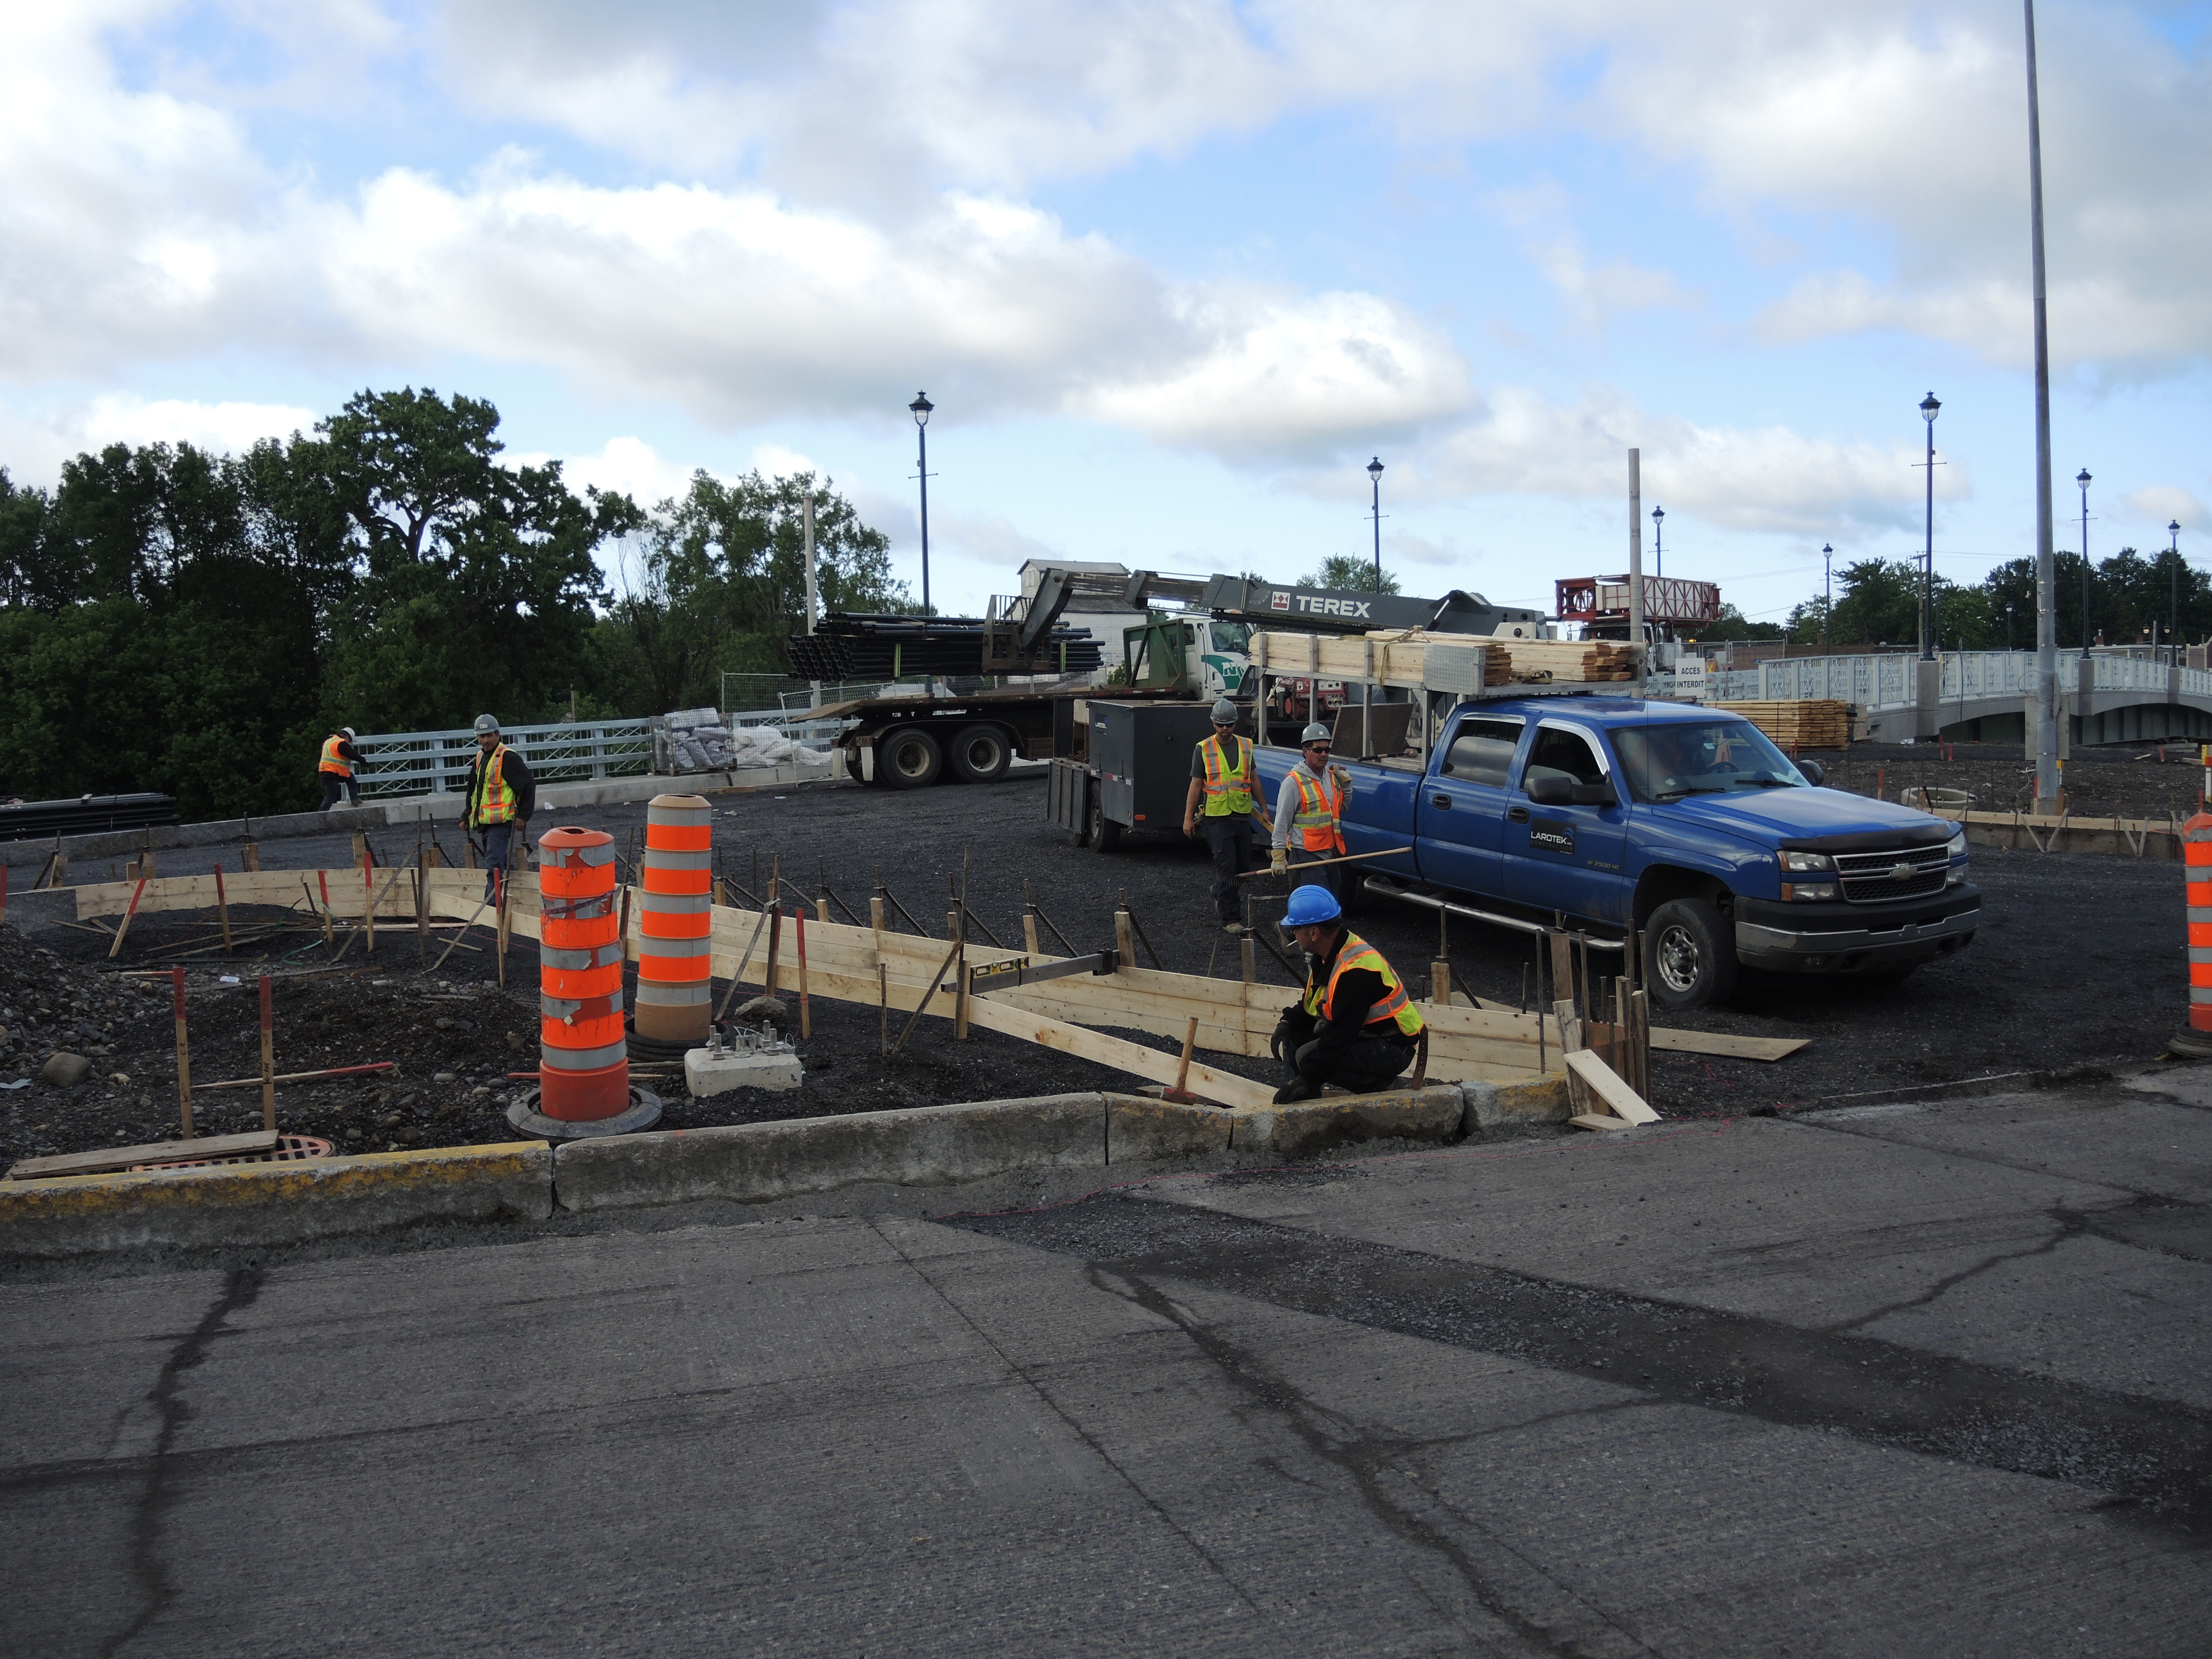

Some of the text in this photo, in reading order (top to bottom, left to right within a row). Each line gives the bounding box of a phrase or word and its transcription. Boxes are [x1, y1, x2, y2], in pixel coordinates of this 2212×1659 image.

[1296, 596, 1371, 618] TEREX
[1681, 665, 1700, 675] ACCÈS
[1677, 680, 1704, 688] INTERDIT
[1531, 831, 1567, 845] LAROTEK
[1530, 839, 1573, 852] CONSTRUCTION
